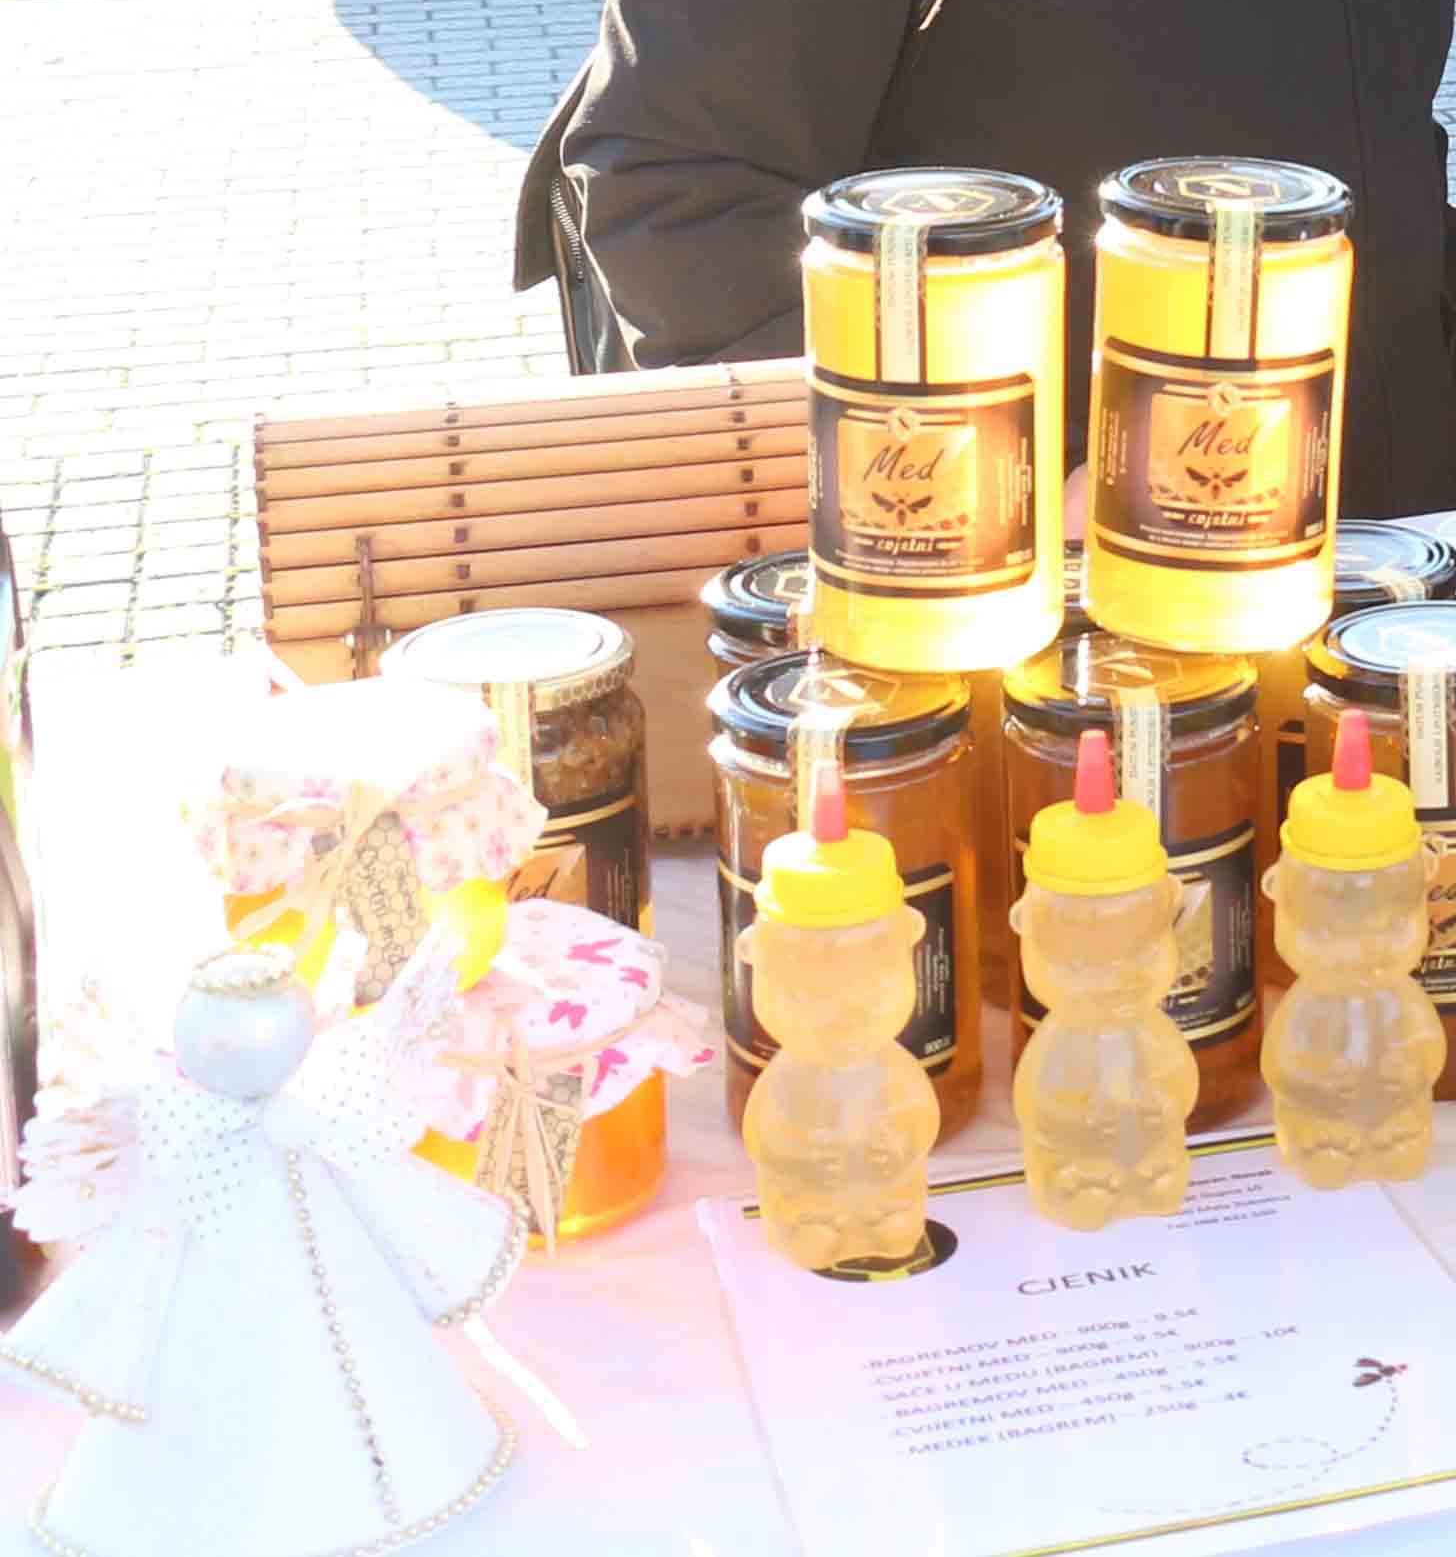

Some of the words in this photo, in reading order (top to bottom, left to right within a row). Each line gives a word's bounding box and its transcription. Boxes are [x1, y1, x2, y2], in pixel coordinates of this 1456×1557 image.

[1176, 419, 1259, 458] Med
[863, 443, 945, 483] Med
[1017, 1261, 1159, 1296] CJENIK
[968, 1369, 1041, 1388] MEDU
[1045, 1348, 1160, 1378] (BAGREM)
[978, 1353, 1032, 1369] MED
[1035, 1378, 1089, 1395] MED
[998, 1412, 1117, 1443] (BAGREM)
[1000, 1403, 1055, 1420] MED
